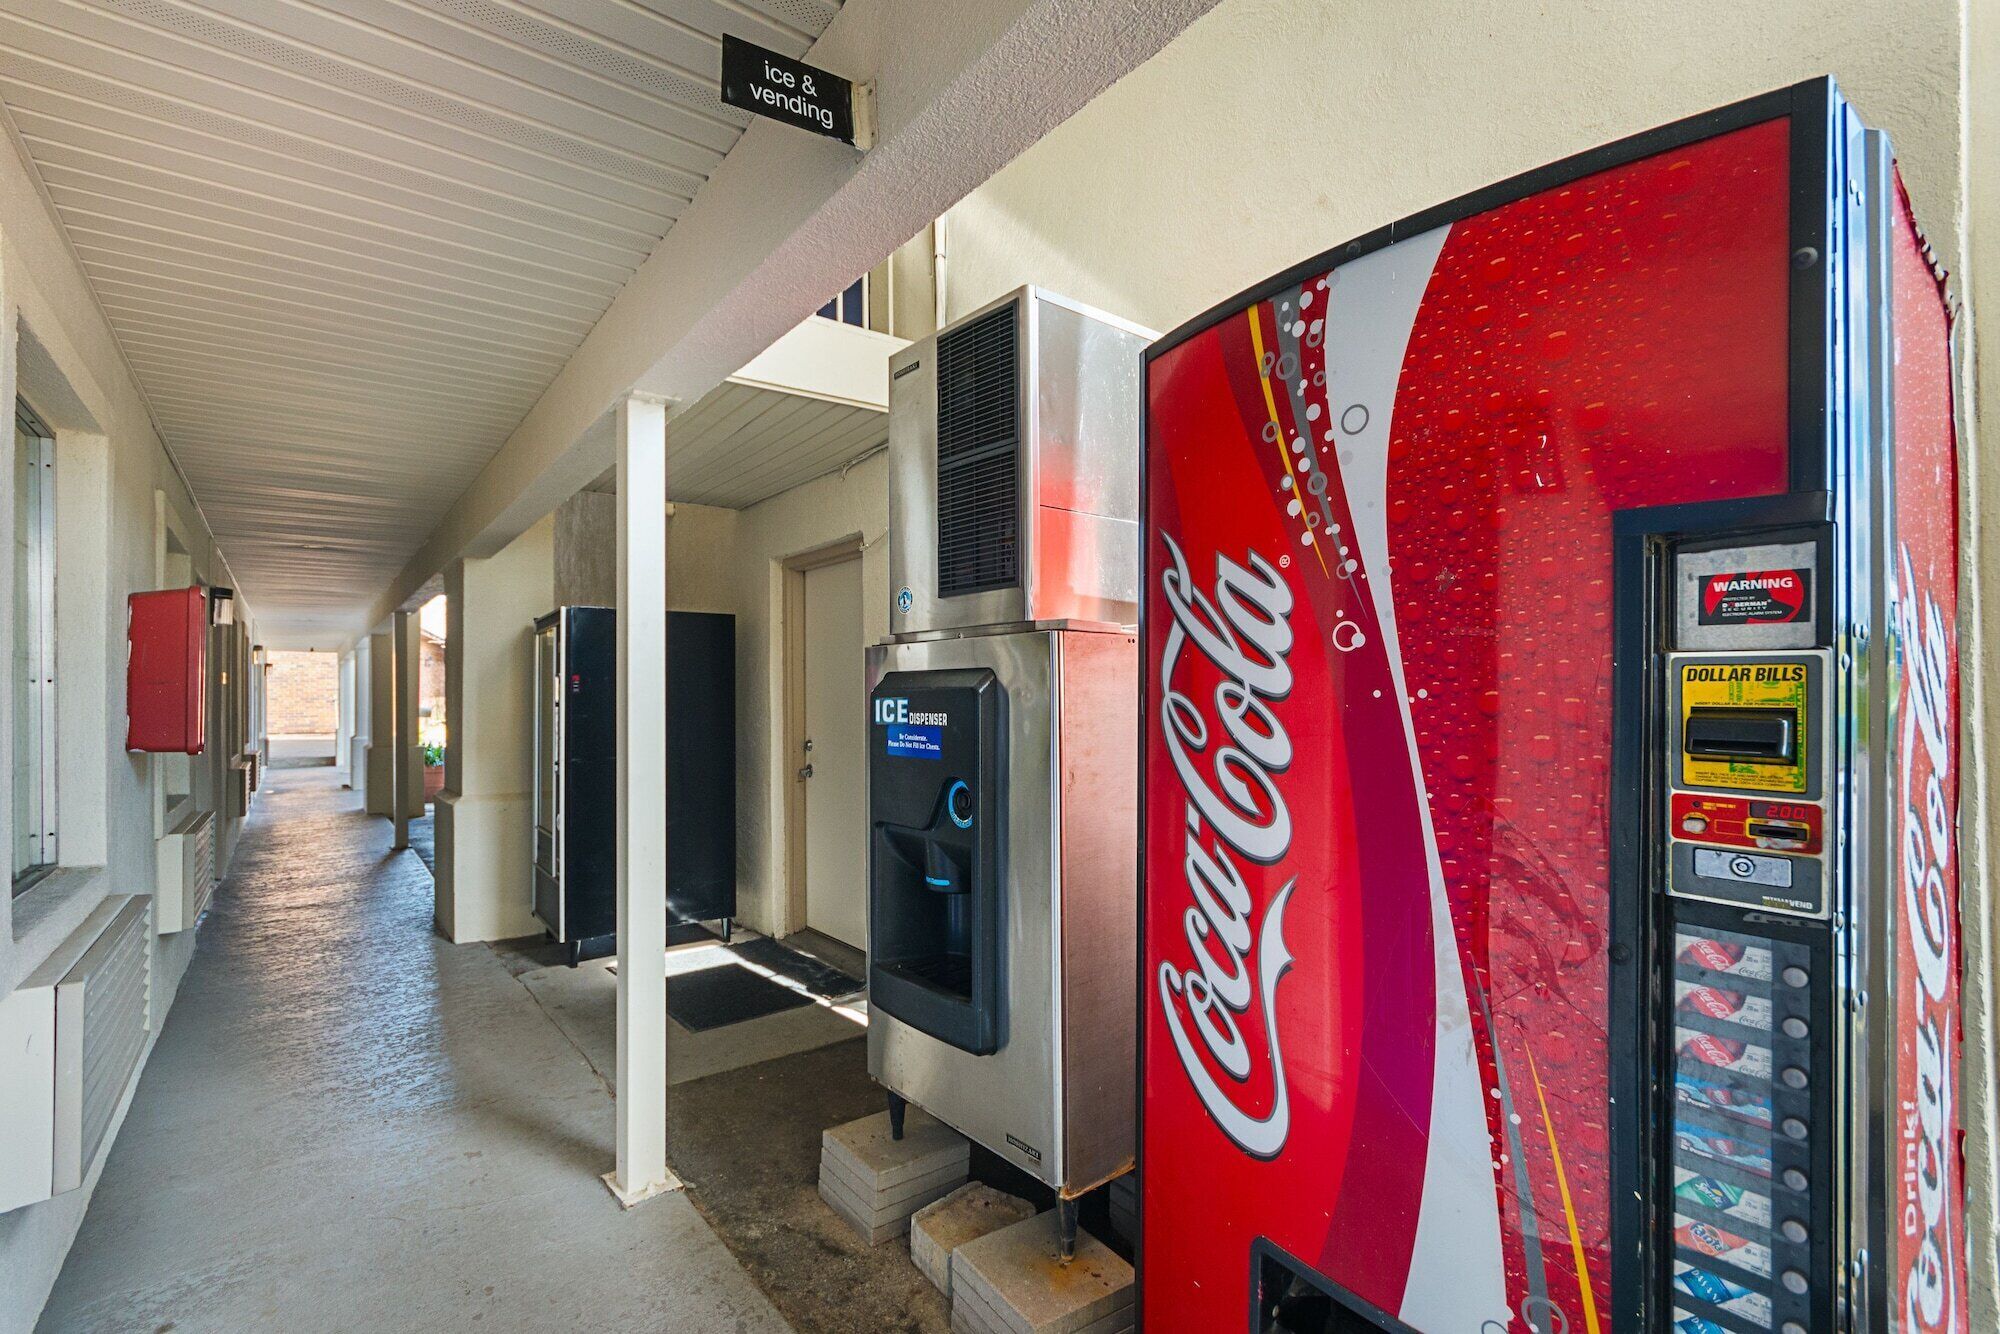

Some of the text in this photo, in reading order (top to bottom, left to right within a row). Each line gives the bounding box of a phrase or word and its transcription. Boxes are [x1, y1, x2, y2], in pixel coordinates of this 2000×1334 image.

[764, 60, 818, 97] ice &
[749, 83, 834, 129] vending
[1713, 577, 1793, 592] WARNING
[1686, 667, 1803, 682] DOLLAR BILLS
[875, 699, 908, 723] ICE
[909, 712, 948, 726] DISPENSER
[1158, 528, 1298, 1163] Coca-Cola
[1903, 1101, 1919, 1236] Drink!
